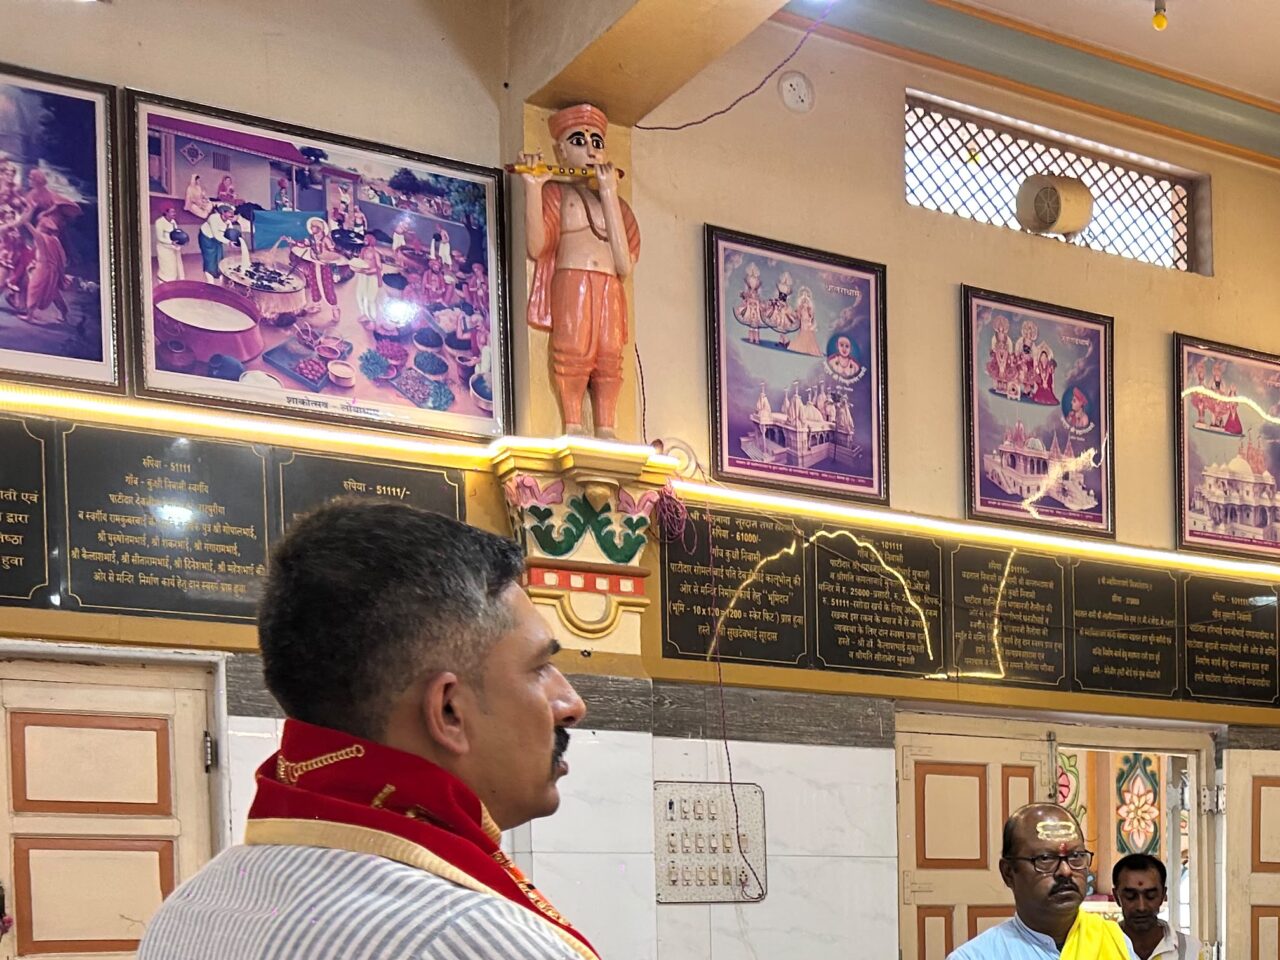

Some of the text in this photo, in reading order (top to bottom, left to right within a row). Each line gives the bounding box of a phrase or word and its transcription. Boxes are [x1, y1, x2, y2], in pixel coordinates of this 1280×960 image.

[286, 395, 328, 409] शाकोत्सव
[170, 462, 191, 472] 51111
[343, 478, 411, 499] रुपिया 51111/-
[21, 490, 39, 504] एवं
[6, 512, 29, 524] द्वारा
[213, 522, 221, 535] श्री
[98, 529, 106, 543] श्री
[152, 535, 161, 547] श्री
[194, 539, 202, 552] श्री
[736, 532, 761, 543] 61000/-
[1, 555, 25, 570] हुवा
[71, 547, 80, 560] श्री
[121, 551, 130, 564] श्री
[174, 557, 183, 570] श्री
[218, 560, 226, 573] श्री
[94, 569, 107, 582] ओर
[108, 569, 115, 582] से
[680, 580, 692, 594] ओर
[693, 580, 699, 595] से
